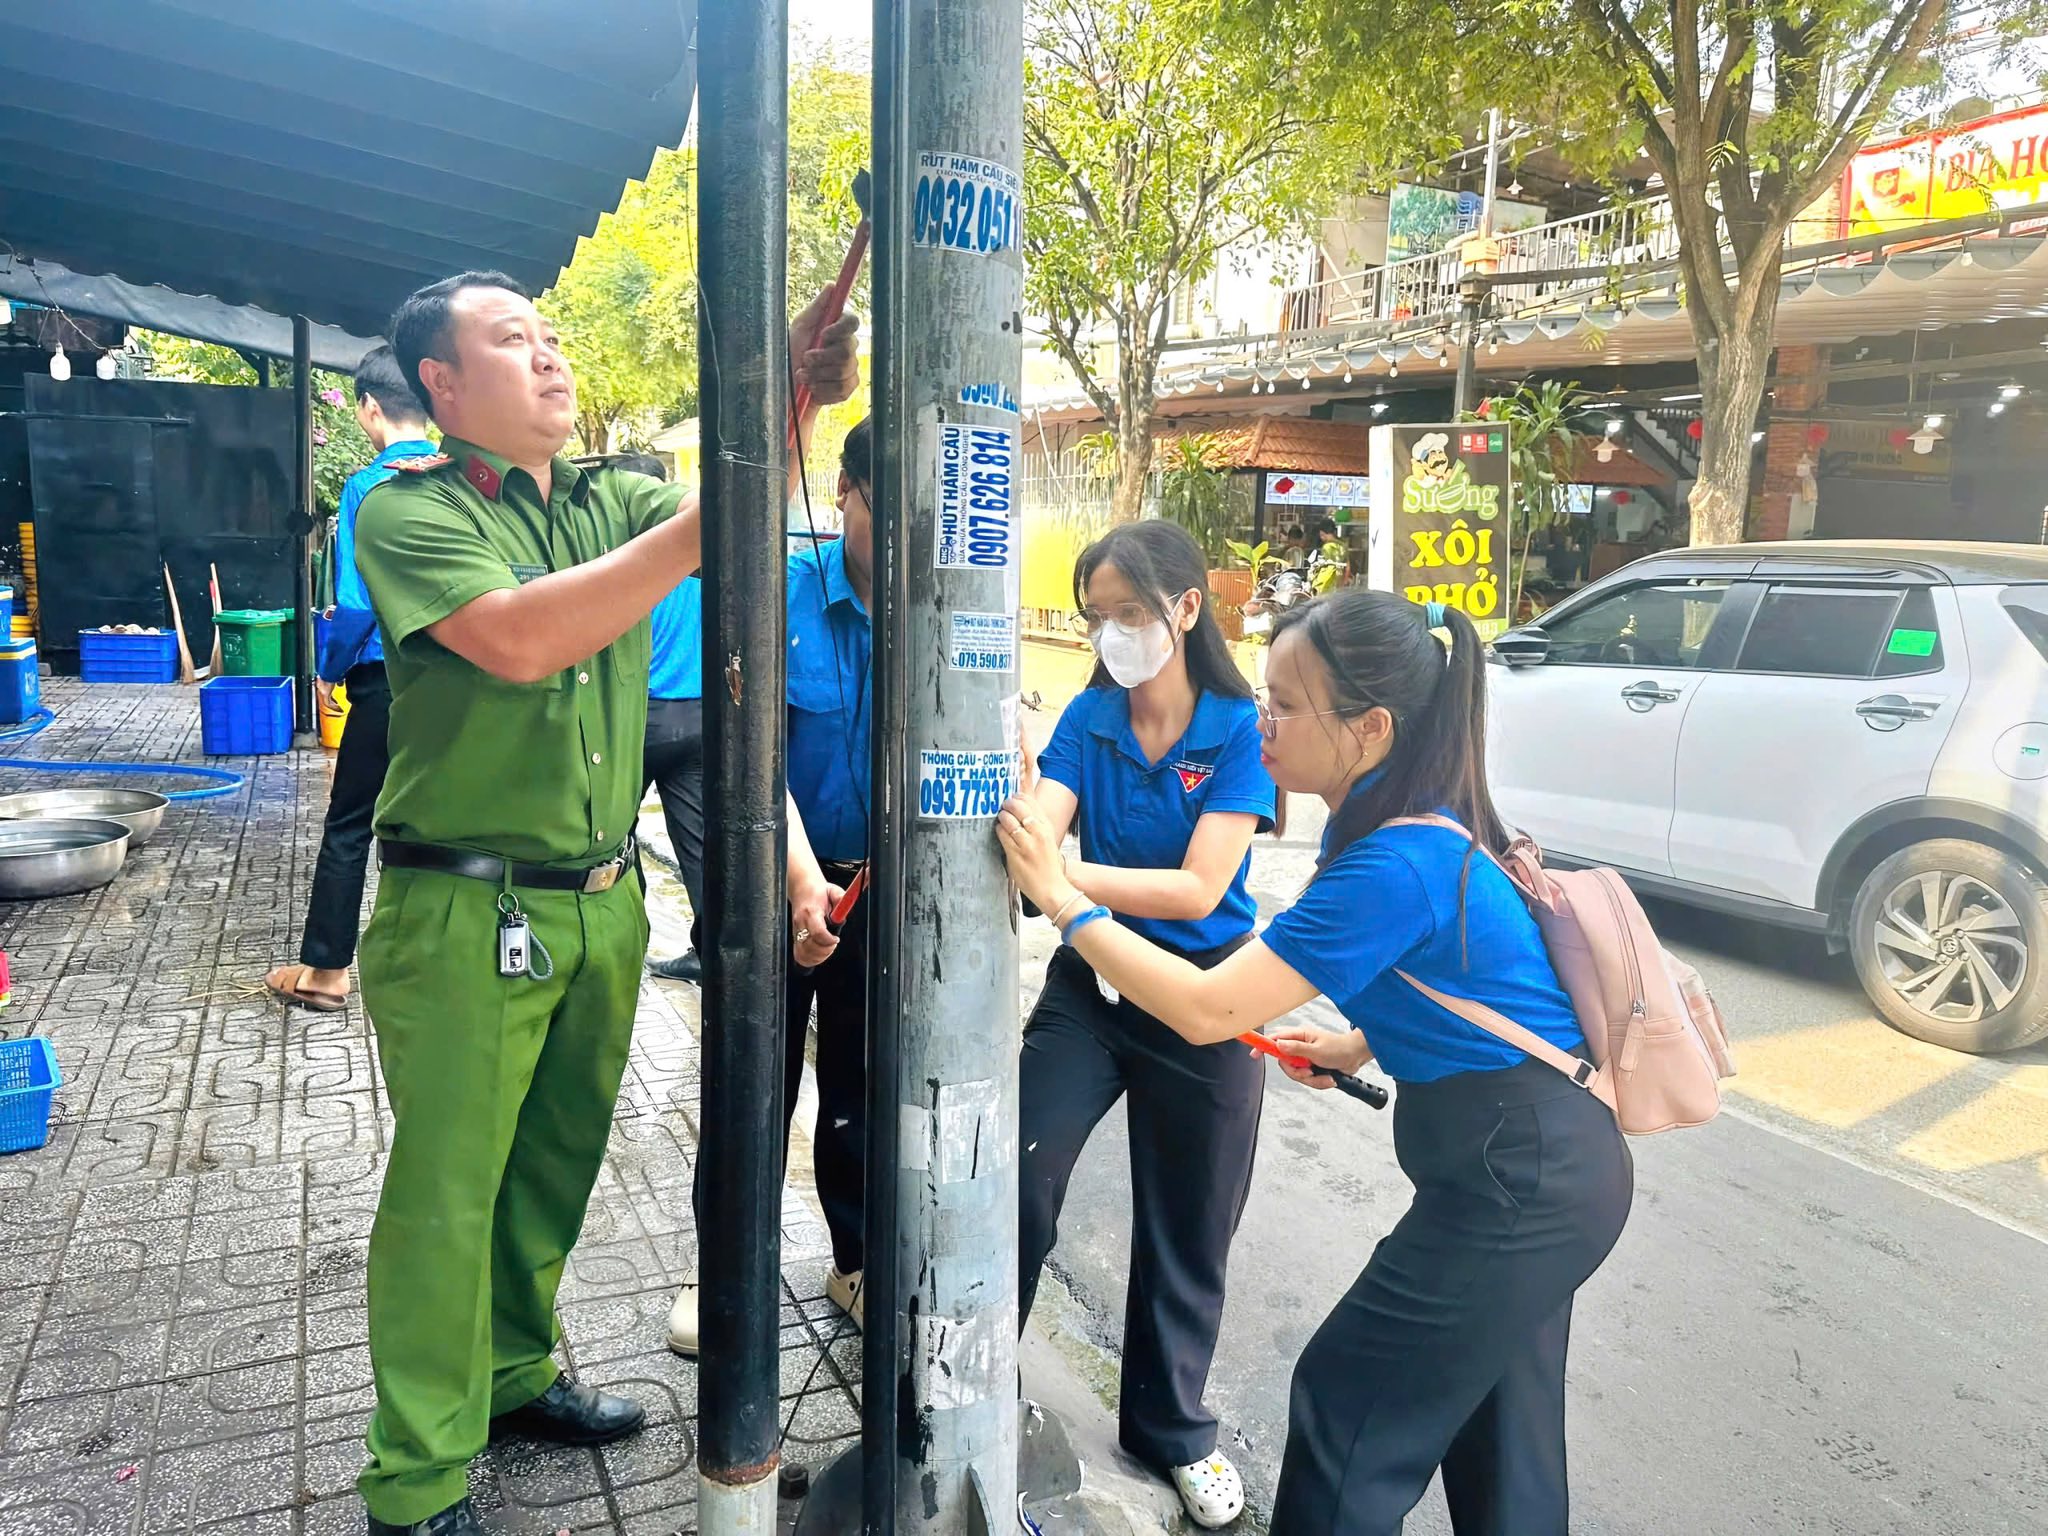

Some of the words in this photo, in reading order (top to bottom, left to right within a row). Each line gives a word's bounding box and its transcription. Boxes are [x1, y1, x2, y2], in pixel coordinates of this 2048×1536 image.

[941, 427, 960, 461] CẦU
[941, 462, 959, 500] HẦM
[967, 430, 1011, 567] 0907.626.814
[940, 502, 958, 535] HÚT
[1409, 518, 1493, 568] XÔI
[936, 766, 966, 779] HÚT
